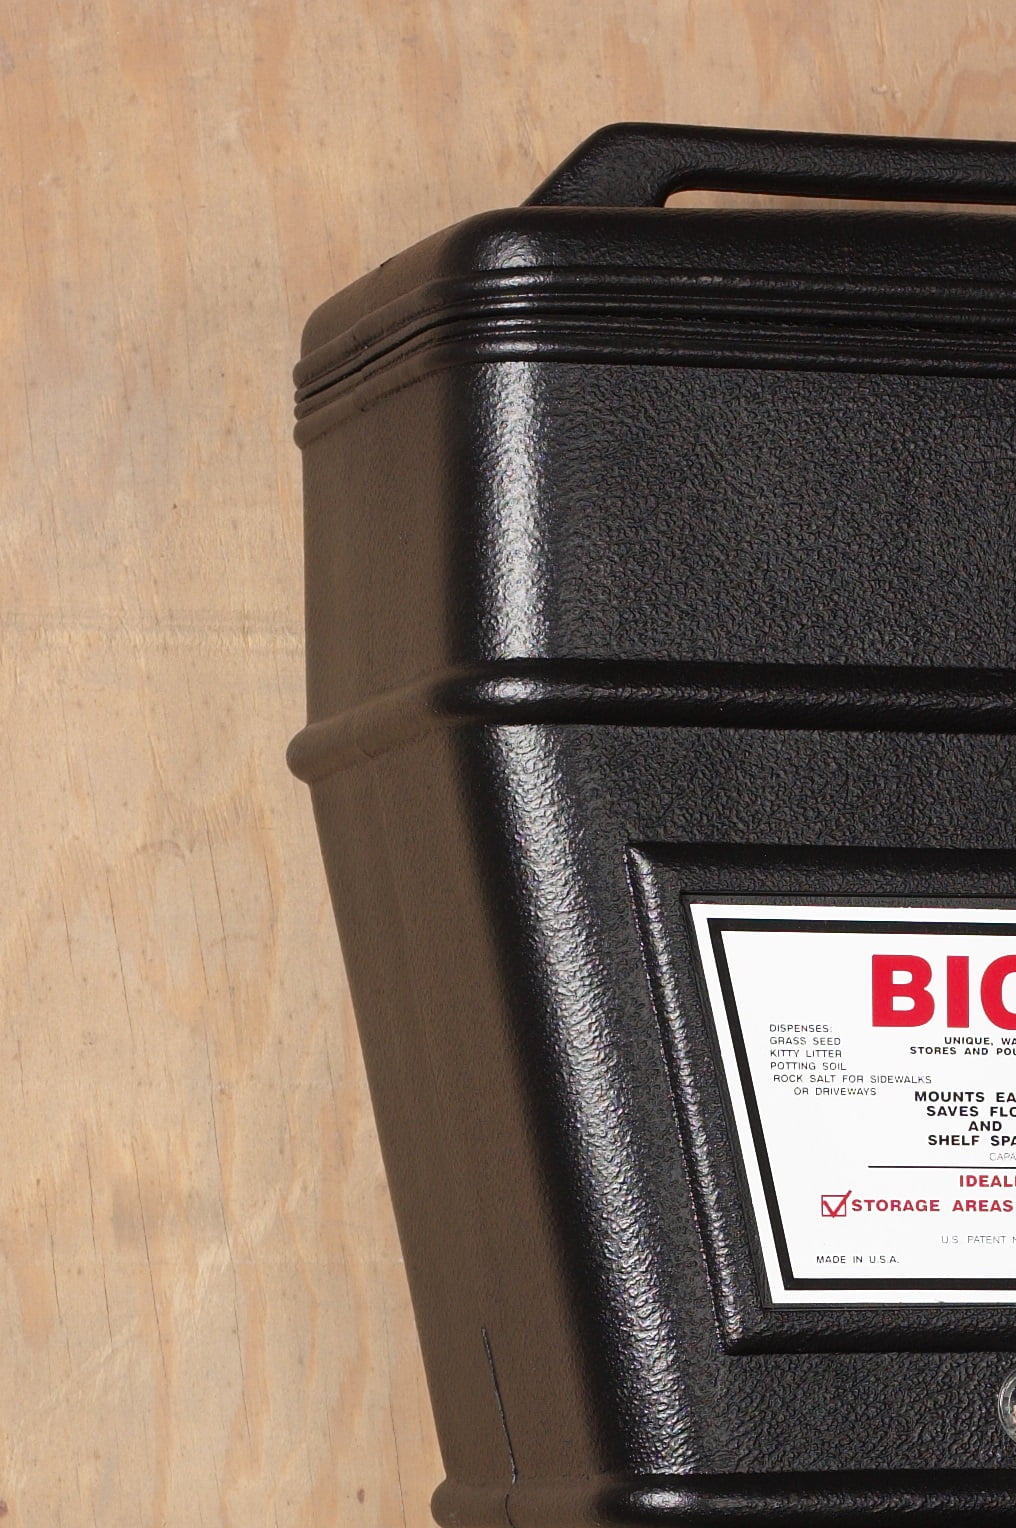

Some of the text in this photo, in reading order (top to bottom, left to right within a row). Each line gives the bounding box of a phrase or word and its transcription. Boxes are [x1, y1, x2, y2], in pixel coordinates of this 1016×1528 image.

[770, 1024, 832, 1032] DISPENSES:
[770, 1037, 840, 1045] GRASS SEED
[944, 1037, 993, 1047] UNIQUE,
[910, 1047, 956, 1055] STORES
[771, 1062, 846, 1070] POTTING SOIL
[843, 1075, 863, 1083] FOR
[870, 1075, 931, 1083] SIDEWALKS
[794, 1087, 808, 1095] OR
[915, 1091, 984, 1102] MOUNTS
[927, 1106, 978, 1117] SAVES
[968, 1121, 1002, 1131] AND
[928, 1135, 979, 1146] SHELF
[852, 1199, 1013, 1212] STORAGE AREAS
[968, 1236, 1006, 1244] PATENT
